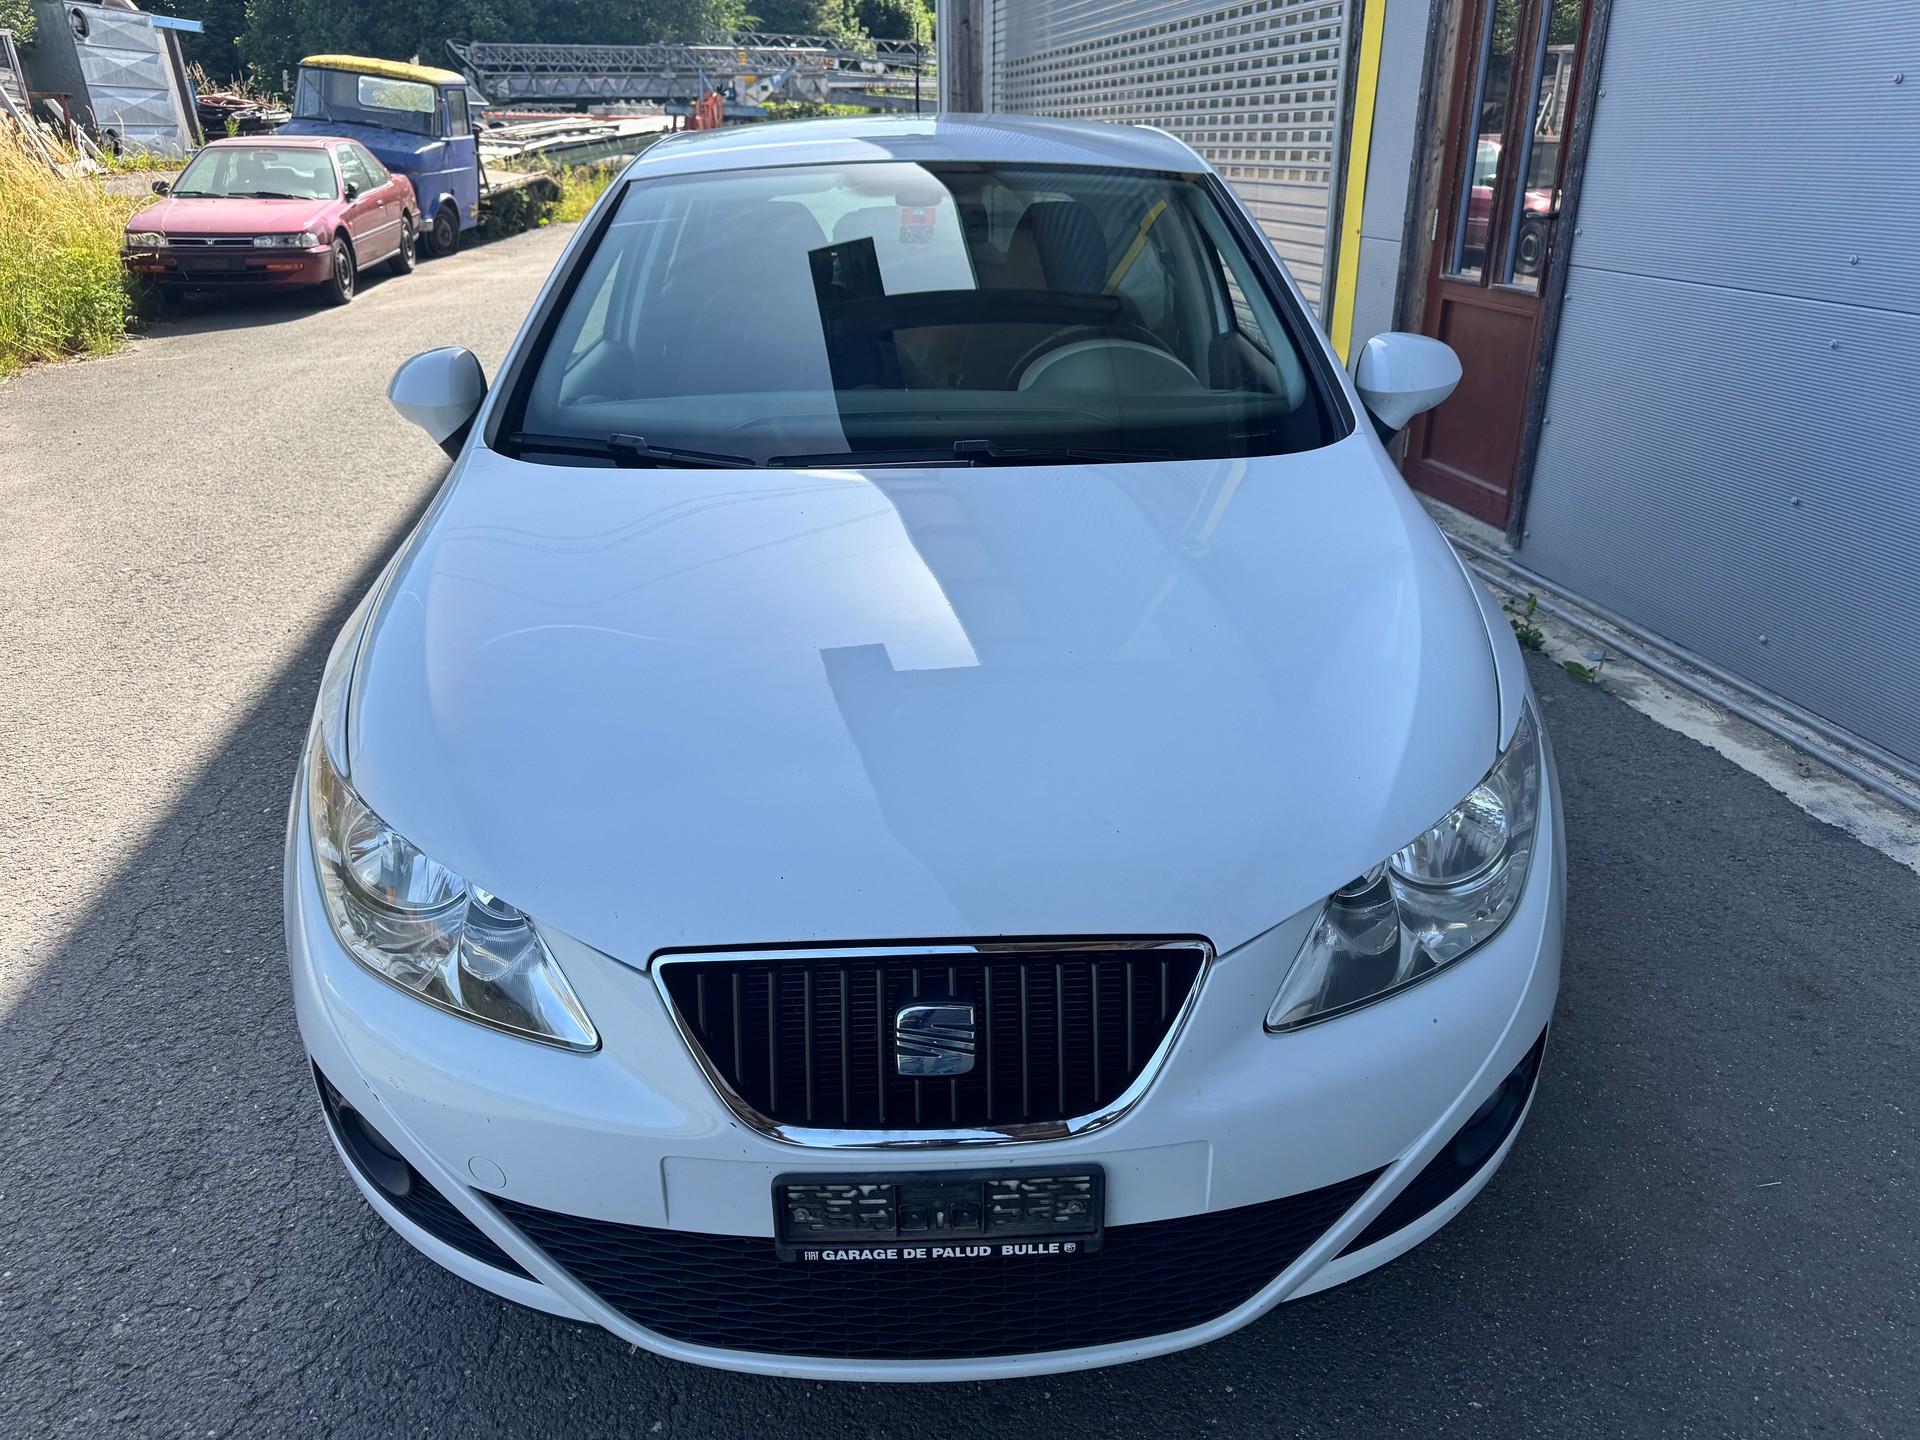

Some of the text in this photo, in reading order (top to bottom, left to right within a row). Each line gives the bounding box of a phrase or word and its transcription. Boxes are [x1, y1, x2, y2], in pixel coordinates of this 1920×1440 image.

[804, 1251, 819, 1261] FIAT
[822, 1249, 898, 1260] GARAGE
[903, 1248, 927, 1259] DE
[932, 1246, 991, 1258] PALUD
[1001, 1243, 1060, 1255] BULLE
